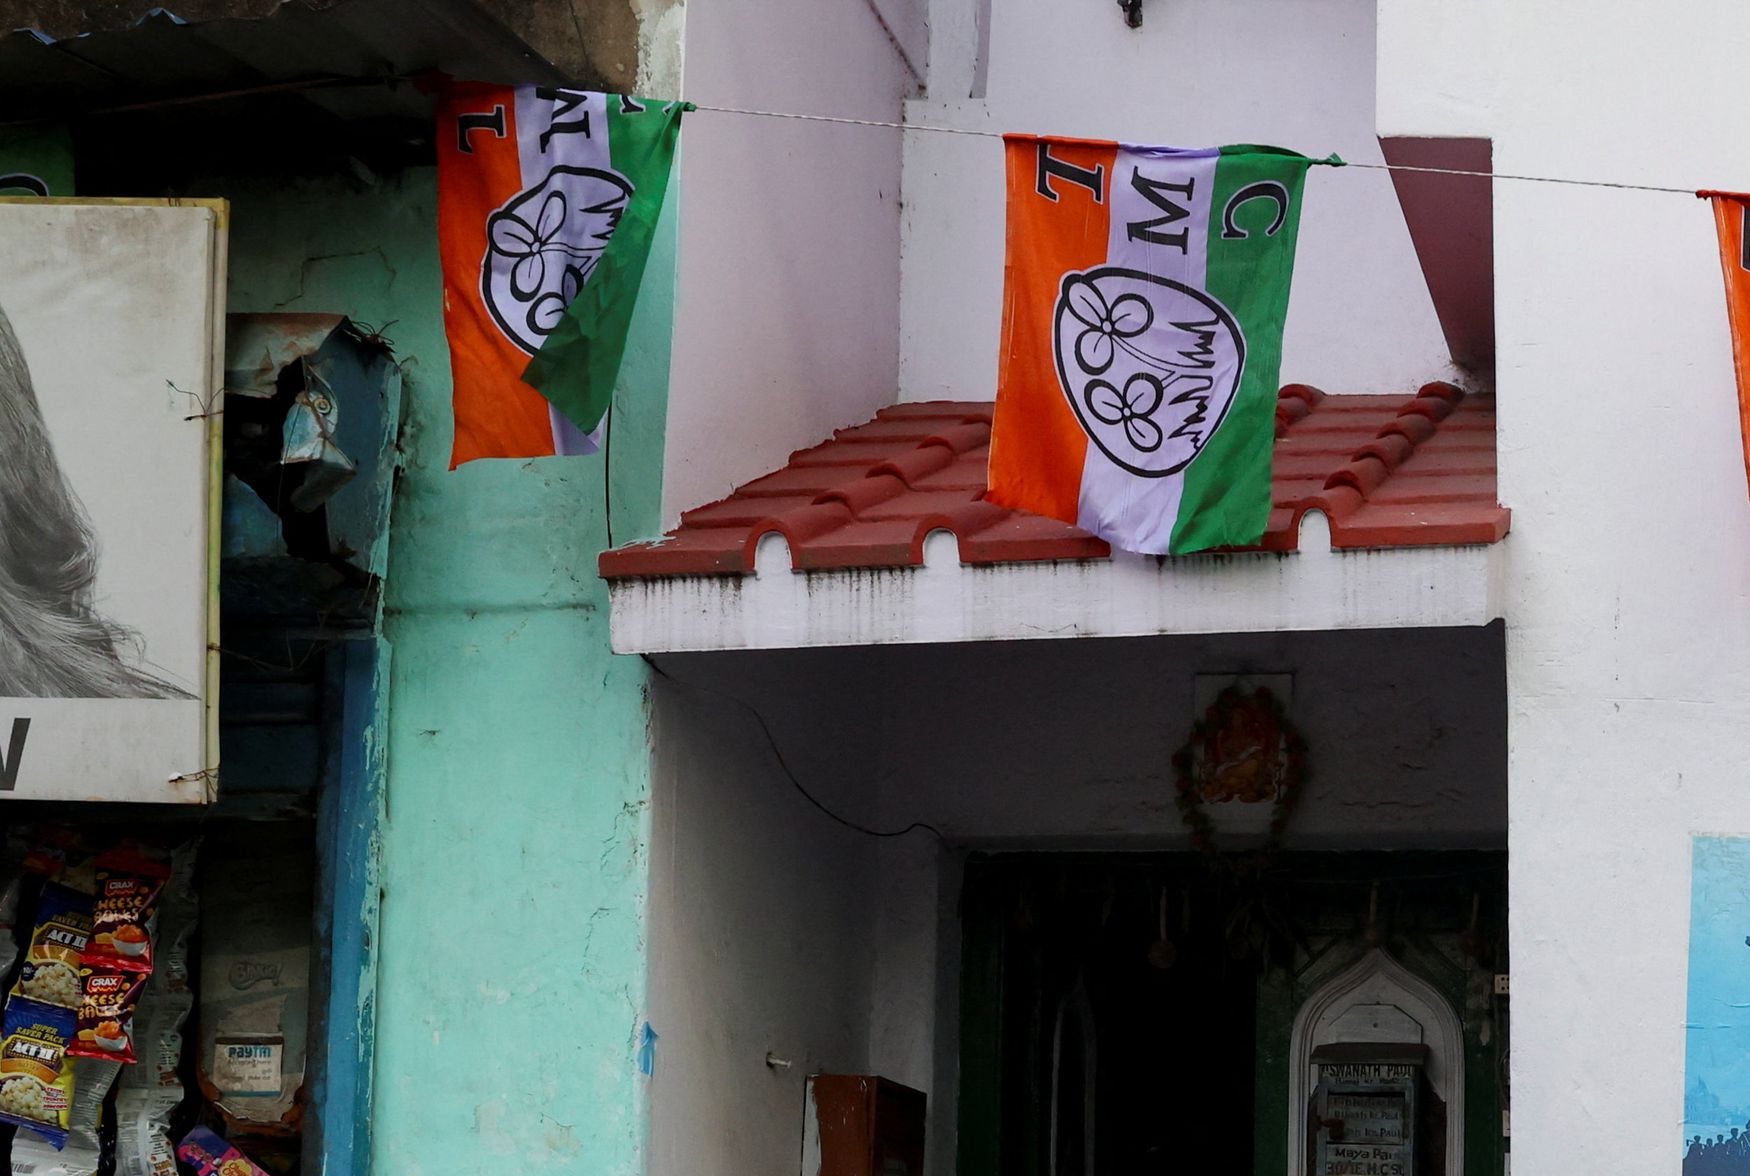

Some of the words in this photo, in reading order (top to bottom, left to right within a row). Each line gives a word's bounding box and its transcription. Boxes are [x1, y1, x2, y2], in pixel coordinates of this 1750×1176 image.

[109, 880, 135, 889] CRAX
[92, 978, 118, 987] CRAX
[32, 1024, 58, 1035] SUPER
[15, 1027, 42, 1039] SAVER
[43, 1034, 65, 1044] PACK
[1335, 1148, 1369, 1160] Maya
